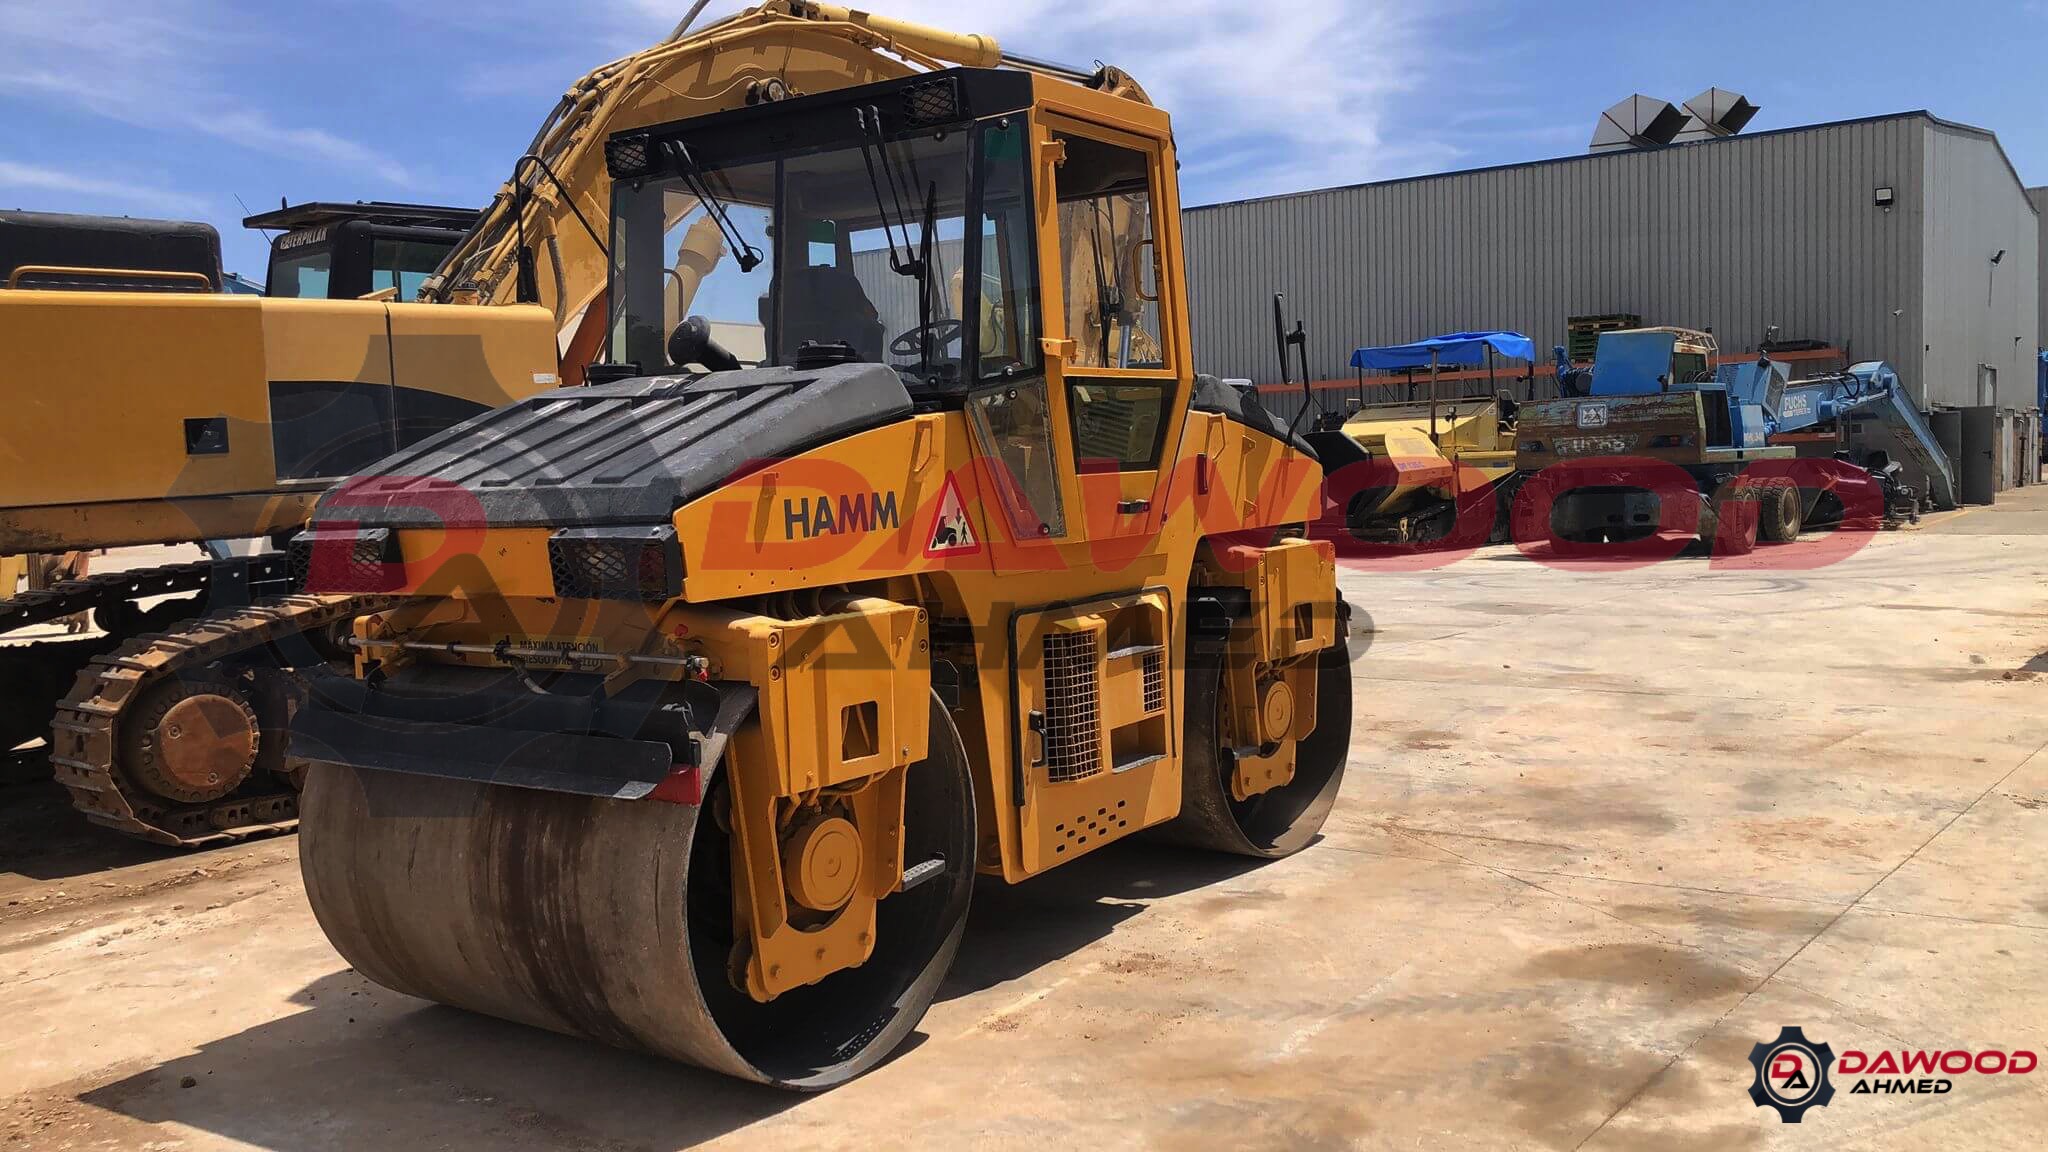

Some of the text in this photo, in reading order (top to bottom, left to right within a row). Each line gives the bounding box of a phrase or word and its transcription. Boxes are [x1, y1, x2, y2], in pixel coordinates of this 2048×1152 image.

[280, 227, 328, 249] CATERPILLAR
[1784, 394, 1807, 411] FUCHS
[783, 490, 899, 540] HAMM
[519, 638, 599, 653] MÁXIMA ATENCIÓN
